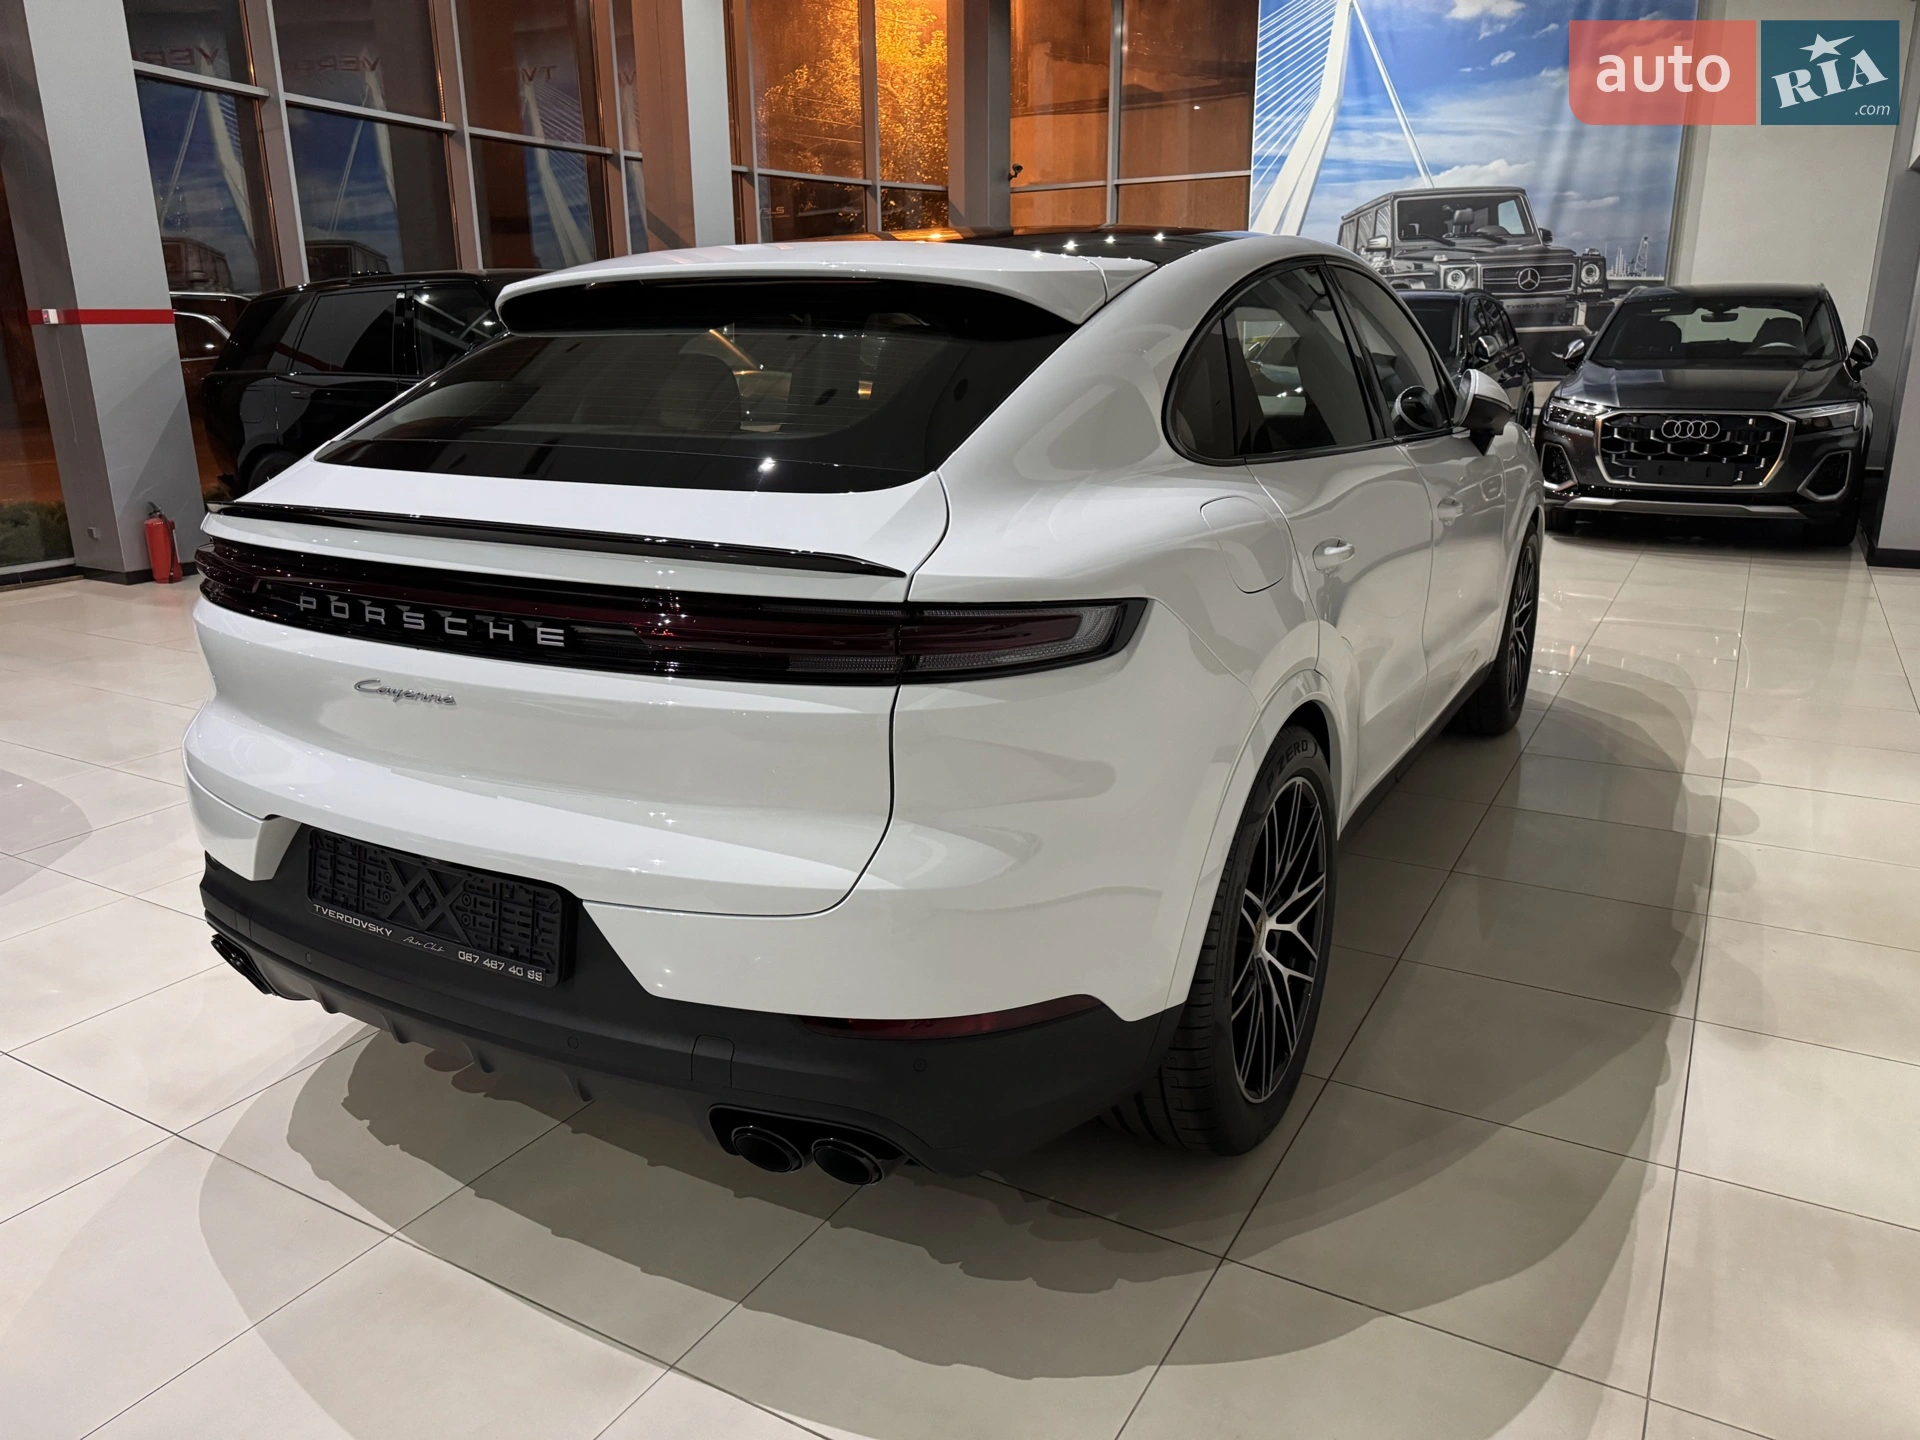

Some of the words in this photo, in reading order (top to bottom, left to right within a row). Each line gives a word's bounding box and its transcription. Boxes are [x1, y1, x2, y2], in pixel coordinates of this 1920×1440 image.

[1506, 302, 1563, 310] TVERDOV
[300, 595, 565, 647] PORSCHE
[354, 679, 457, 706] Cayenne
[313, 903, 393, 937] TVERDOVSKY
[508, 965, 524, 977] 40
